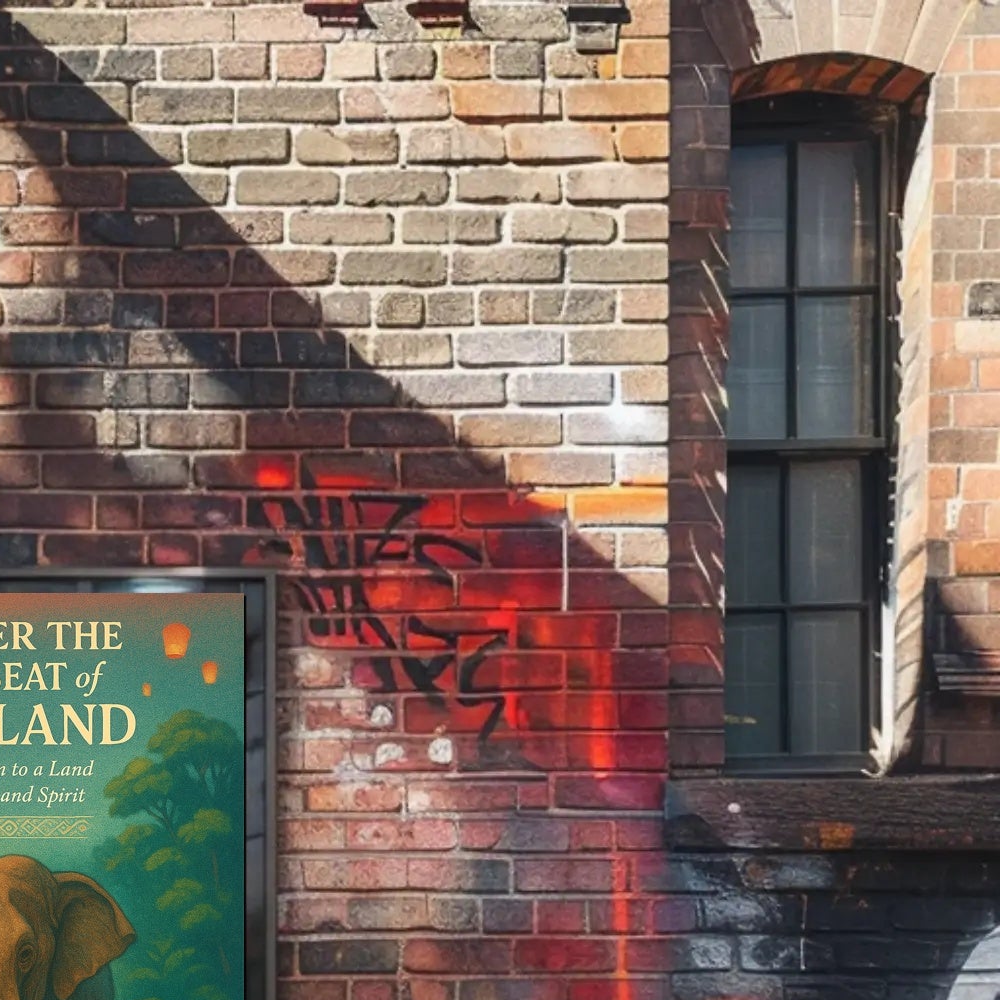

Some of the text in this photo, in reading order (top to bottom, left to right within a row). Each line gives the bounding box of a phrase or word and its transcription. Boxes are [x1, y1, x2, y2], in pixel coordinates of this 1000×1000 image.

[46, 621, 123, 651] THE
[75, 660, 107, 698] of
[11, 762, 28, 777] to
[33, 765, 44, 777] a
[48, 759, 95, 777] Land
[0, 785, 32, 804] and
[36, 786, 86, 810] Spirit
